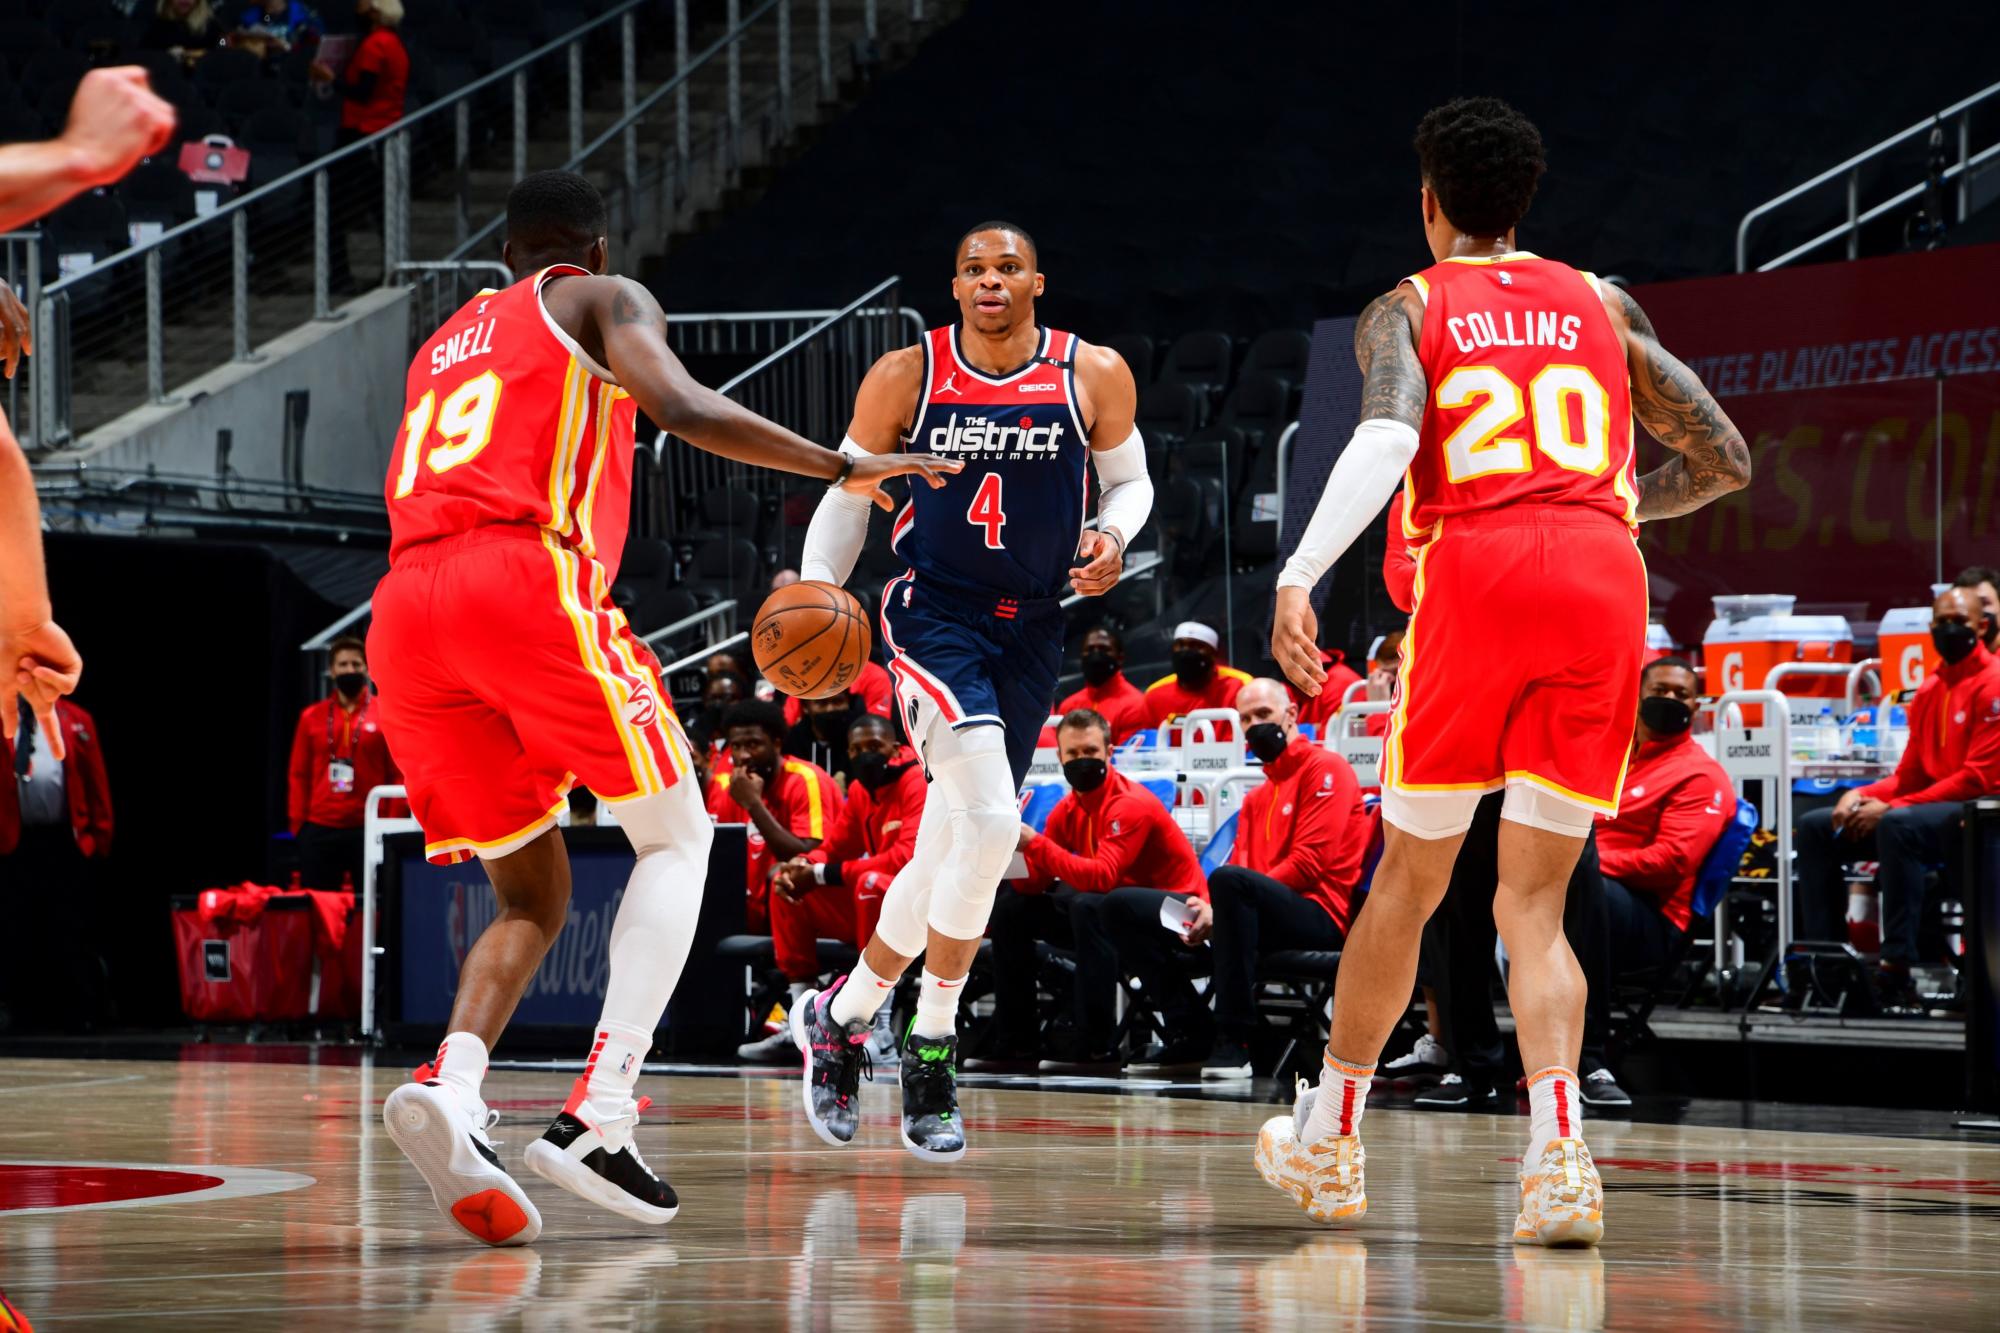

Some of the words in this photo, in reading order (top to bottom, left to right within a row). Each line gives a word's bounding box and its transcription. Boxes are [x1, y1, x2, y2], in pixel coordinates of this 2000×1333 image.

[431, 318, 496, 376] SNELL
[1447, 311, 1581, 353] COLLINS
[1757, 337, 1899, 392] PLAYOFFS
[1903, 326, 2000, 377] ACCES
[1018, 383, 1057, 393] GEICO
[393, 368, 503, 500] 19
[929, 412, 1065, 452] district
[964, 416, 987, 427] THE
[1435, 363, 1610, 484] 20
[958, 452, 1057, 461] COLUMBIA
[967, 472, 1006, 549] 4
[1721, 652, 1744, 692] G
[1901, 644, 1925, 690] G
[1192, 758, 1228, 769] GATORADE
[1727, 745, 1771, 758] GATORADE
